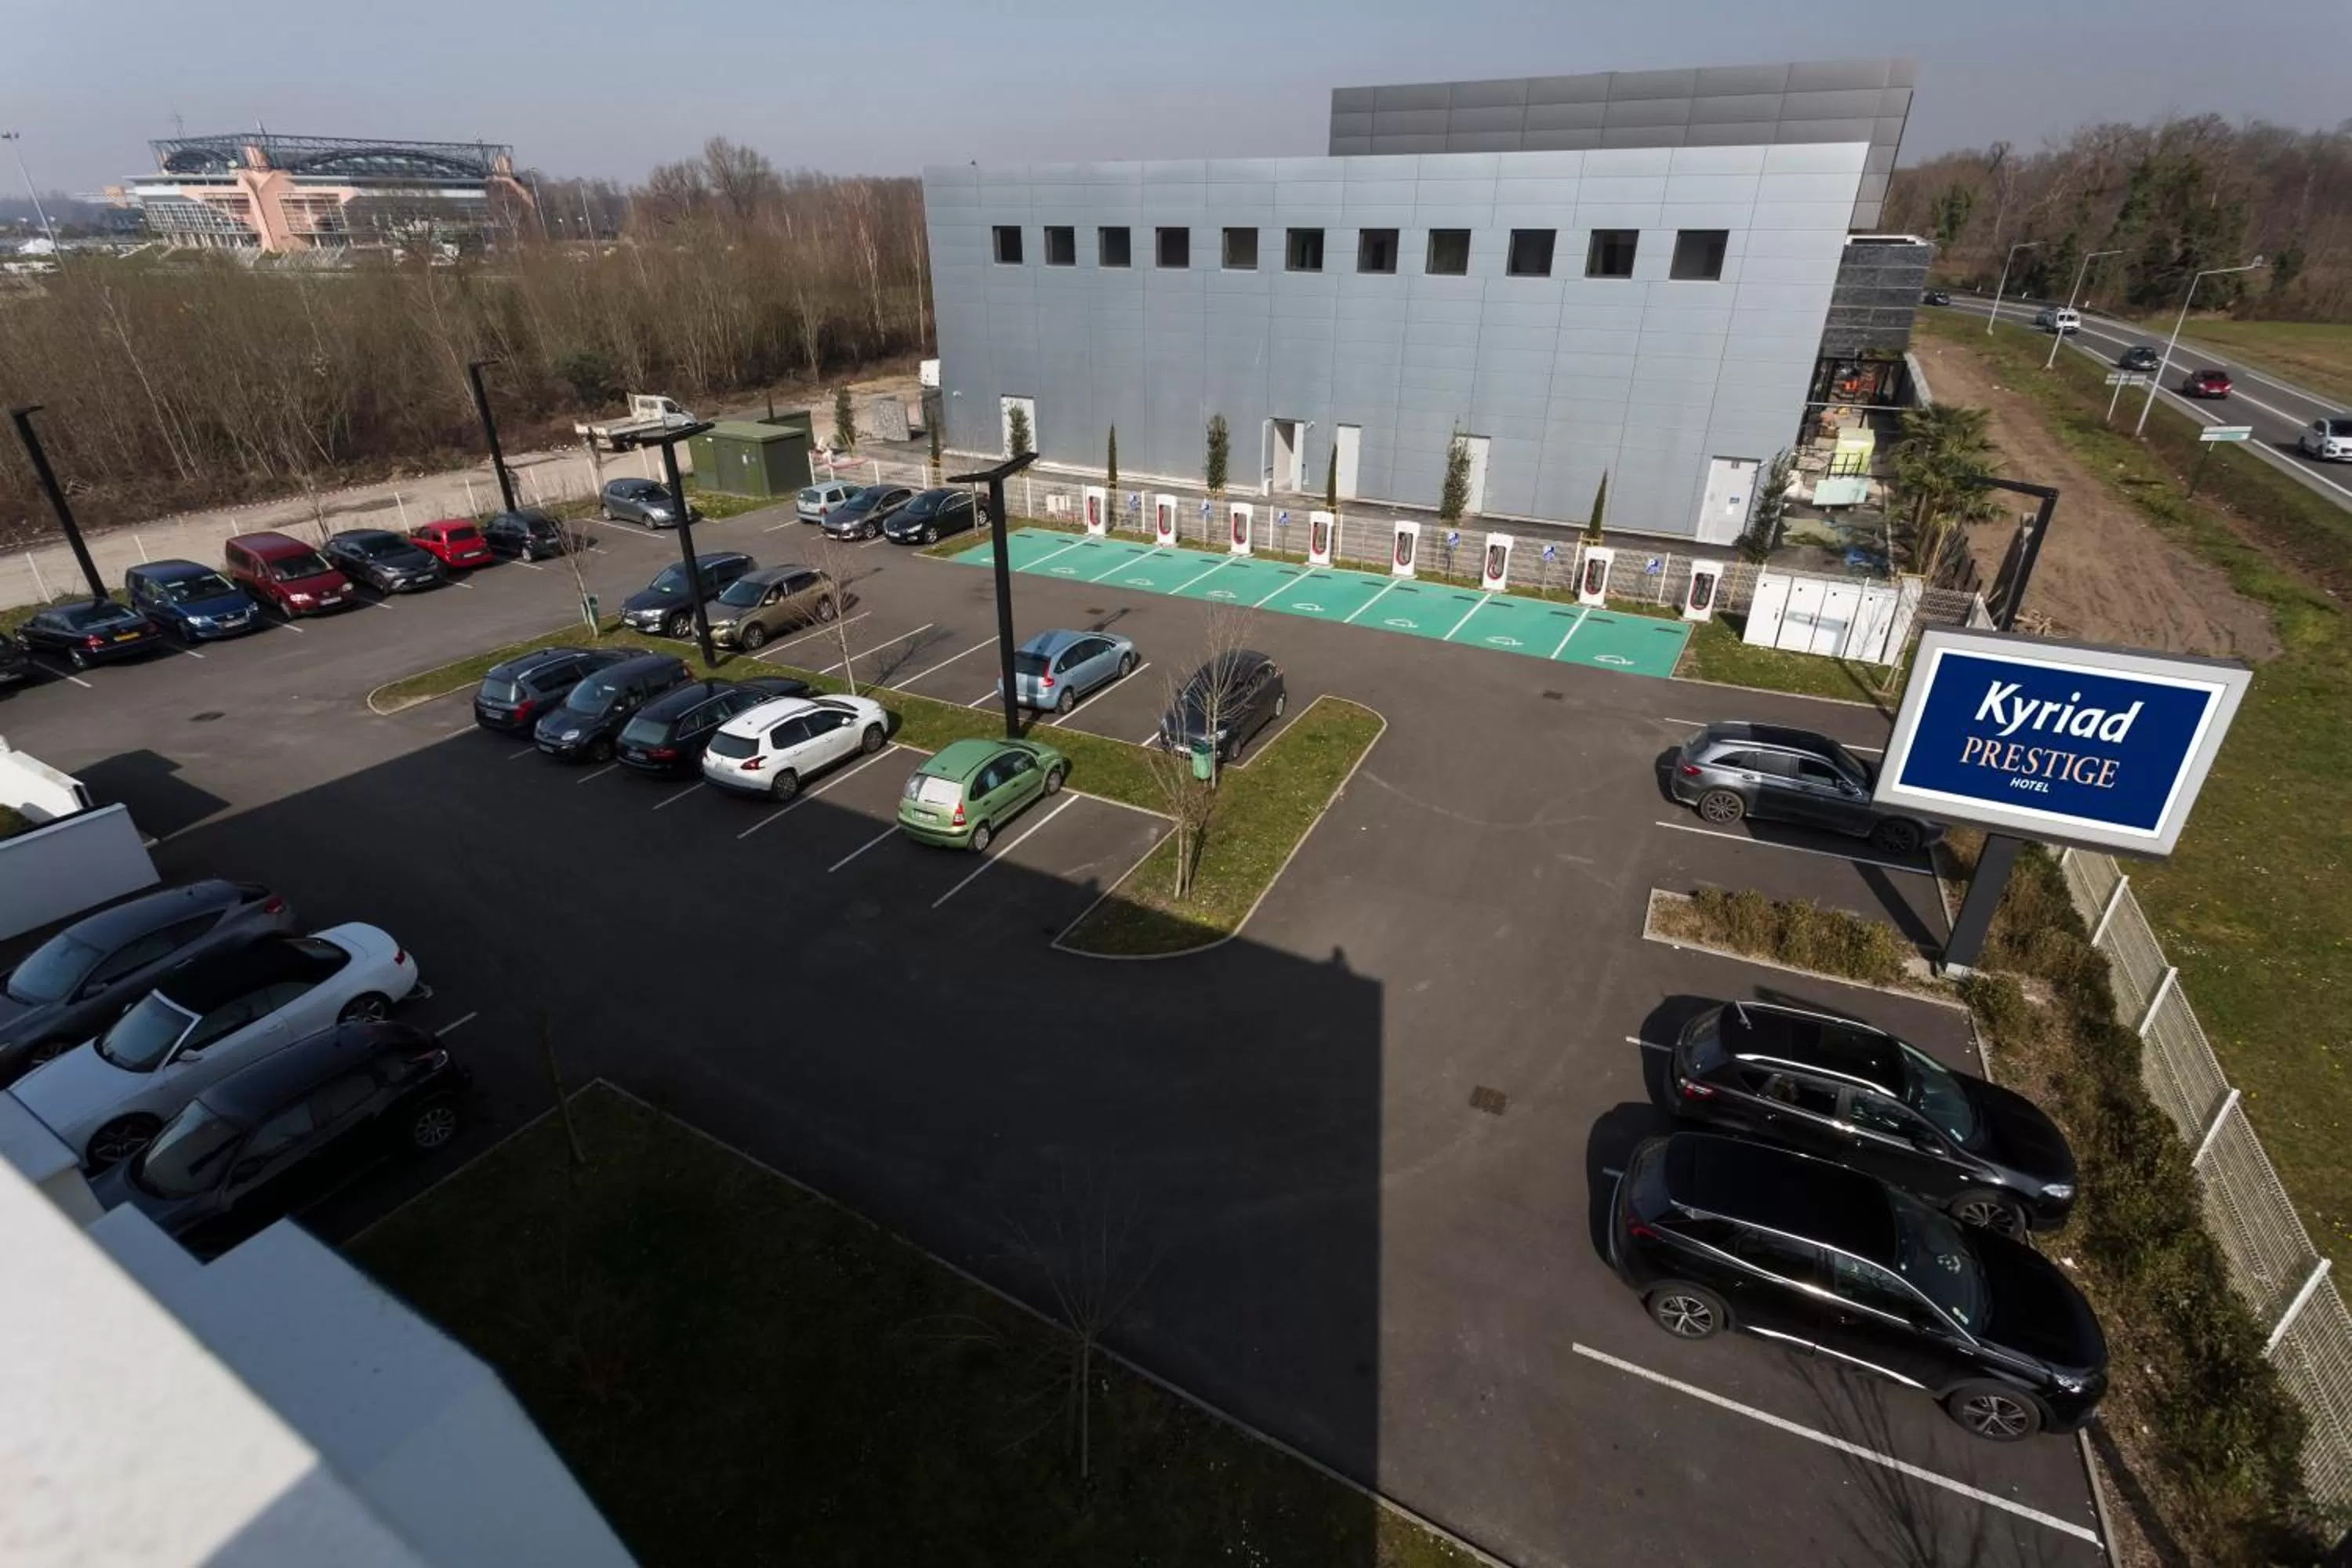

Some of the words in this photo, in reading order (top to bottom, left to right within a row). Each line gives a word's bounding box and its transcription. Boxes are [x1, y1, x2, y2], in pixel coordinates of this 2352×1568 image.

[1974, 680, 2145, 743] Kyriad
[1960, 736, 2120, 788] PRESTIGE
[2009, 777, 2049, 793] HOTEL
